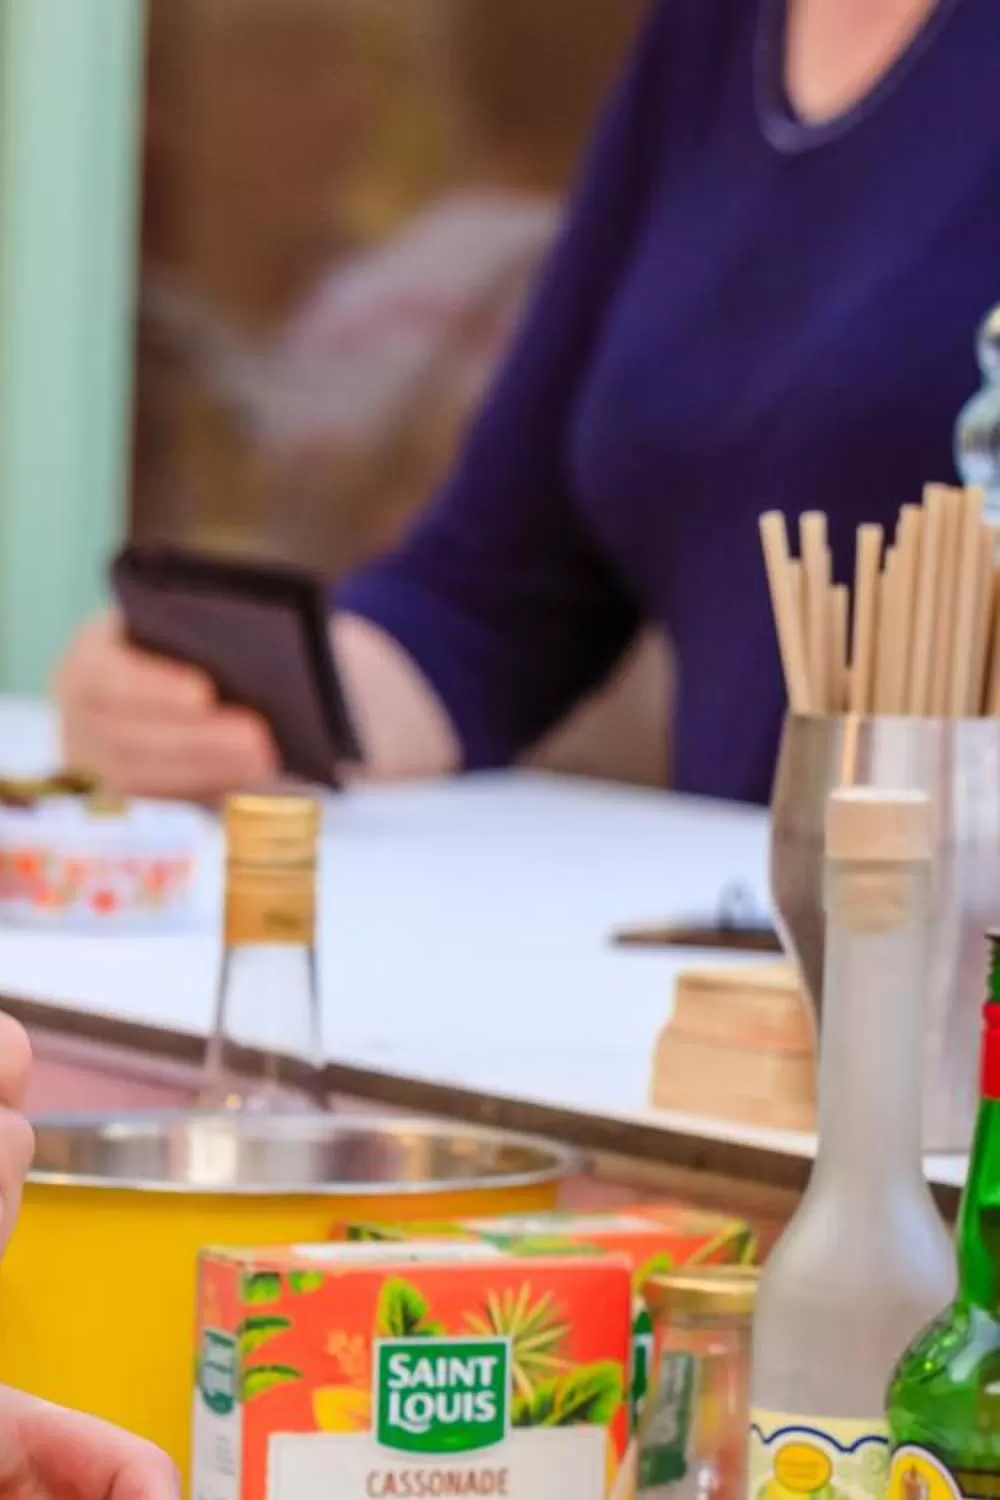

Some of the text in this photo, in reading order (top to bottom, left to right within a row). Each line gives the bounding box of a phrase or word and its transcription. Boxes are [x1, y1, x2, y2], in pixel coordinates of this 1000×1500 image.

[388, 1353, 497, 1388] SAINT
[388, 1390, 497, 1433] LOUIS
[365, 1467, 510, 1499] CASSONADE
